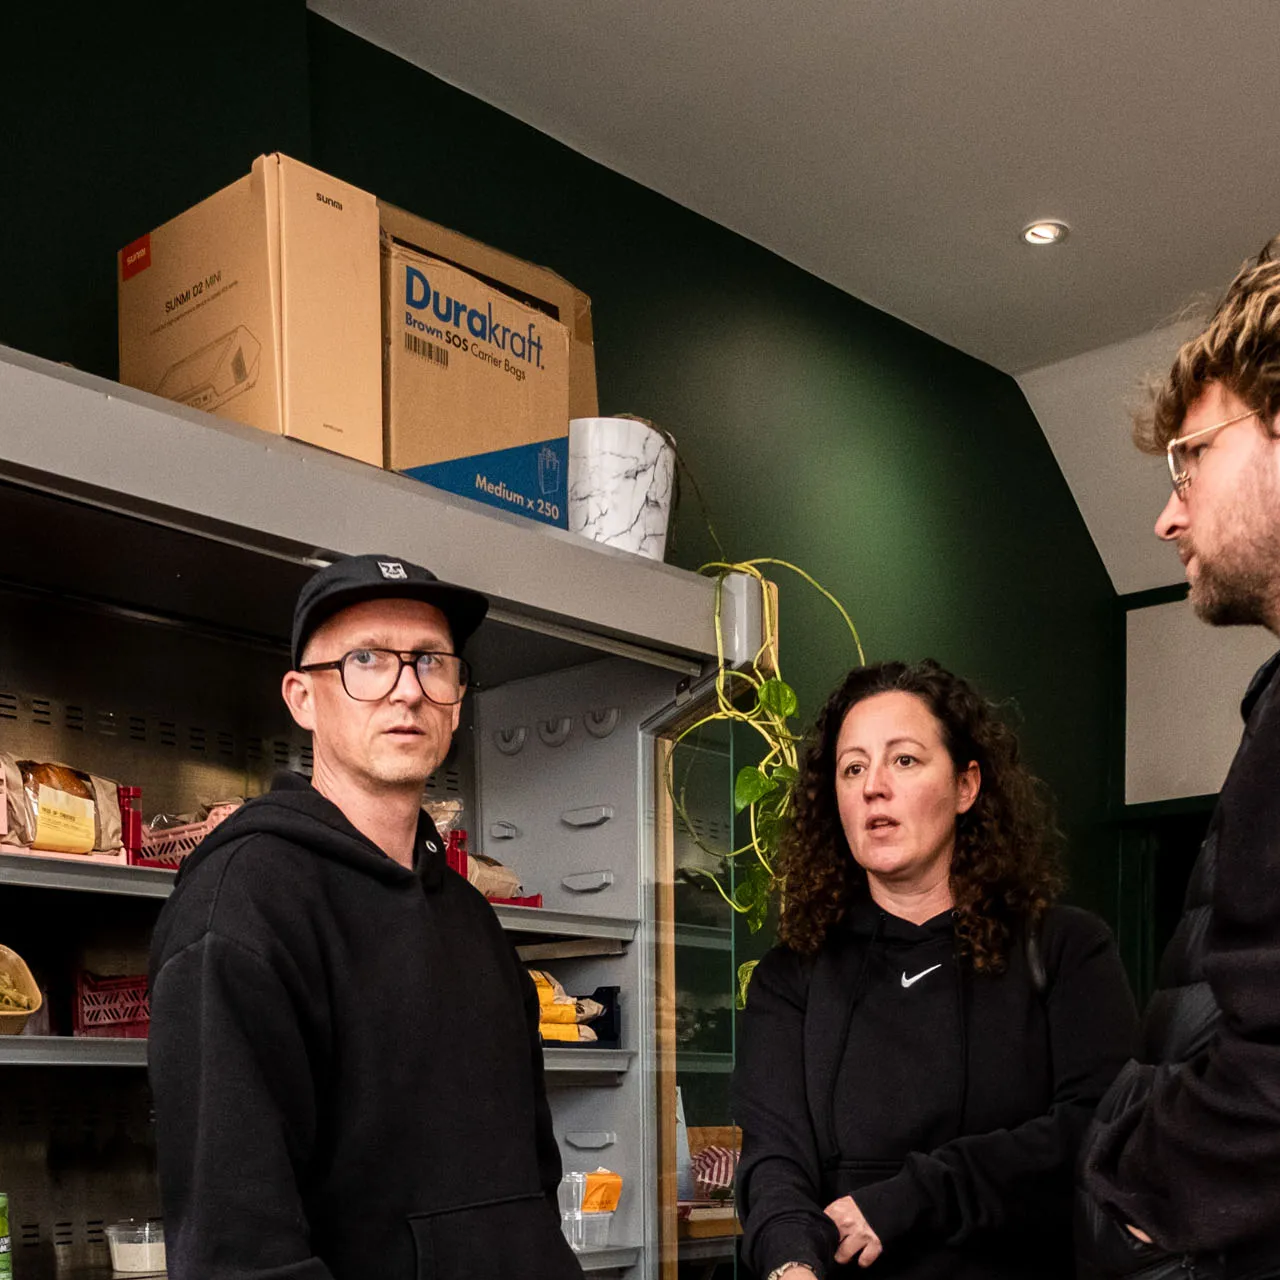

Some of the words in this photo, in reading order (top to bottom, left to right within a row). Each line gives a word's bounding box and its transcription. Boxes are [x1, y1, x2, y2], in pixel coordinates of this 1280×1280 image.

[165, 290, 191, 313] SUNMI
[405, 312, 443, 340] Brown
[445, 330, 469, 352] SOS
[471, 343, 502, 369] Carrier
[504, 358, 526, 381] Bags
[475, 473, 524, 506] Medium
[537, 498, 559, 520] 250
